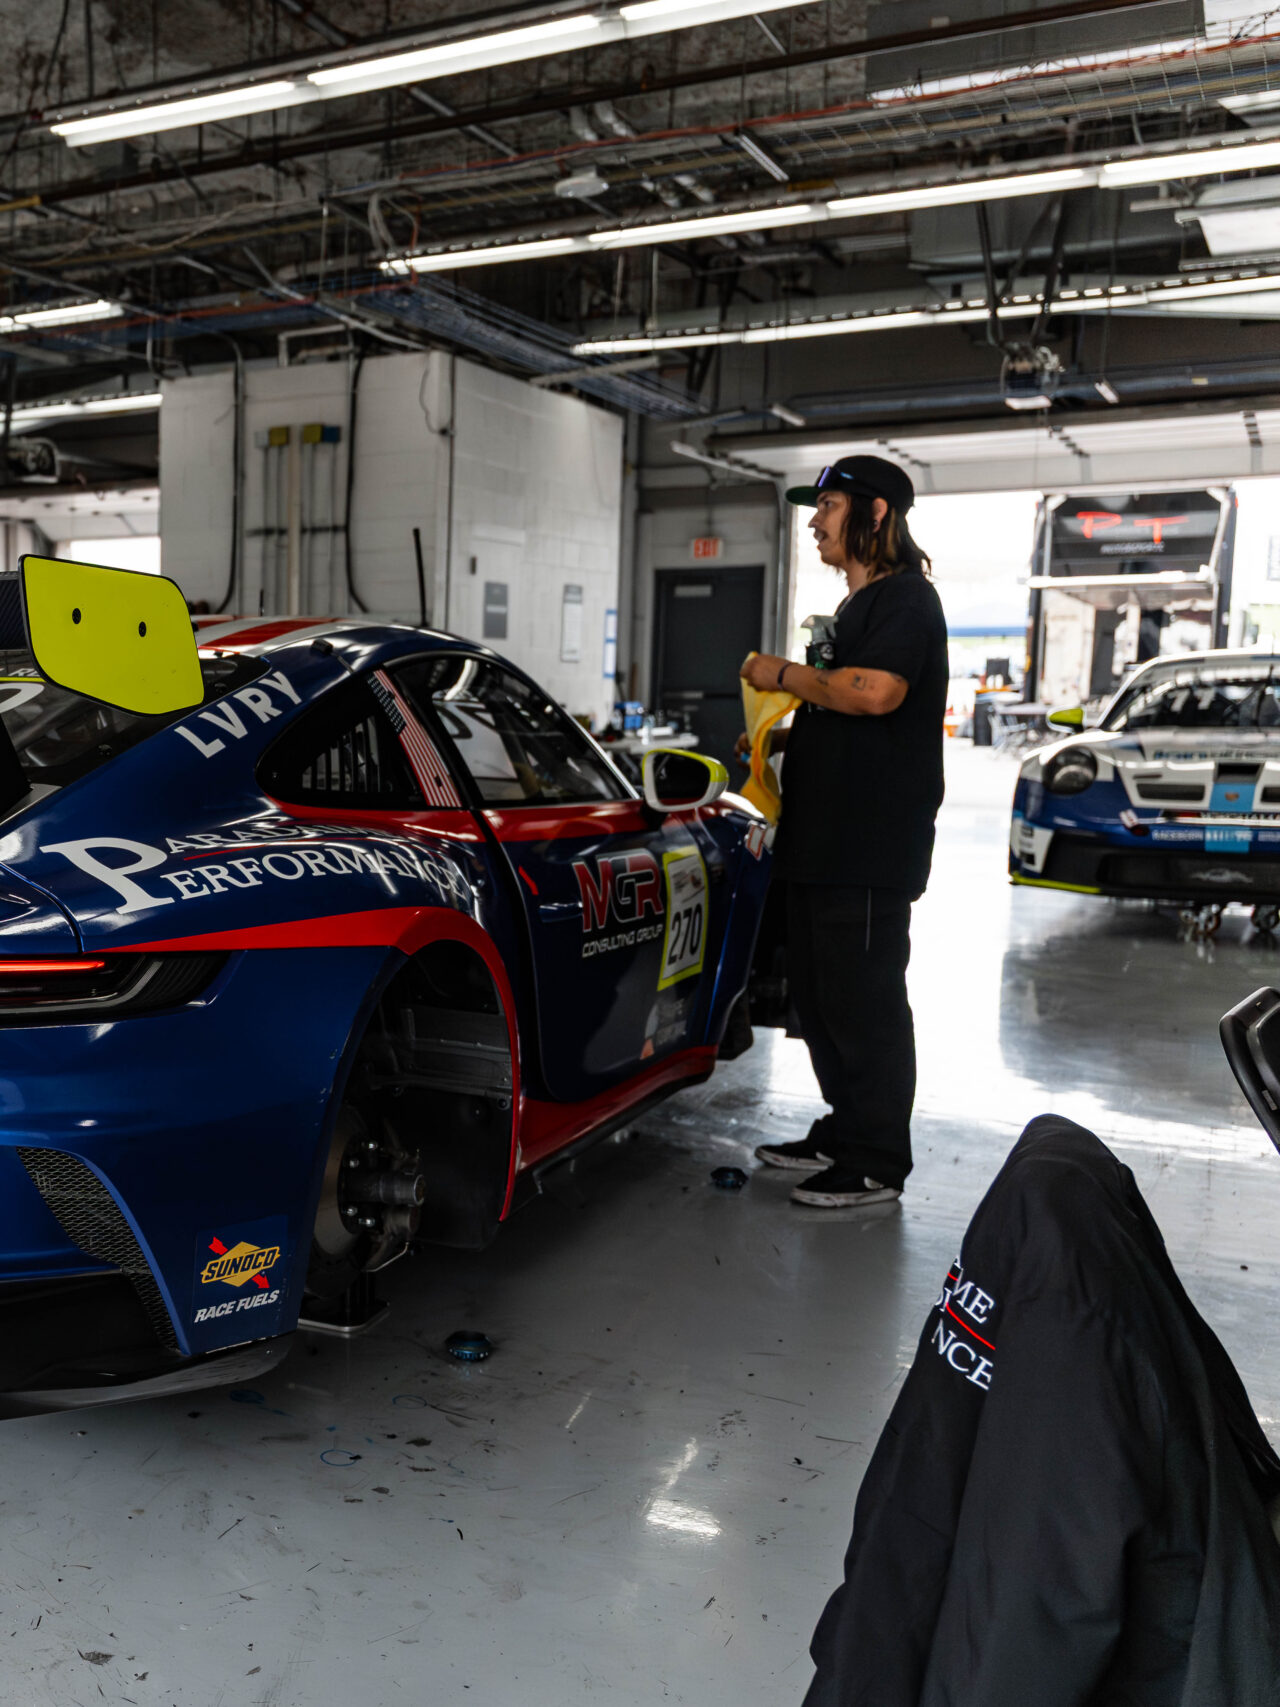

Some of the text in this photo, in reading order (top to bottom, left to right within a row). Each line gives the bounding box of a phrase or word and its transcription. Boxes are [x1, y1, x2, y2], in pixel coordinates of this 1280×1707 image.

[173, 670, 303, 759] LVRY
[582, 924, 663, 959] CONSULTING GROUP
[667, 903, 703, 967] 270
[203, 1248, 279, 1282] SUNOCO
[194, 1289, 280, 1323] RACE FUELS
